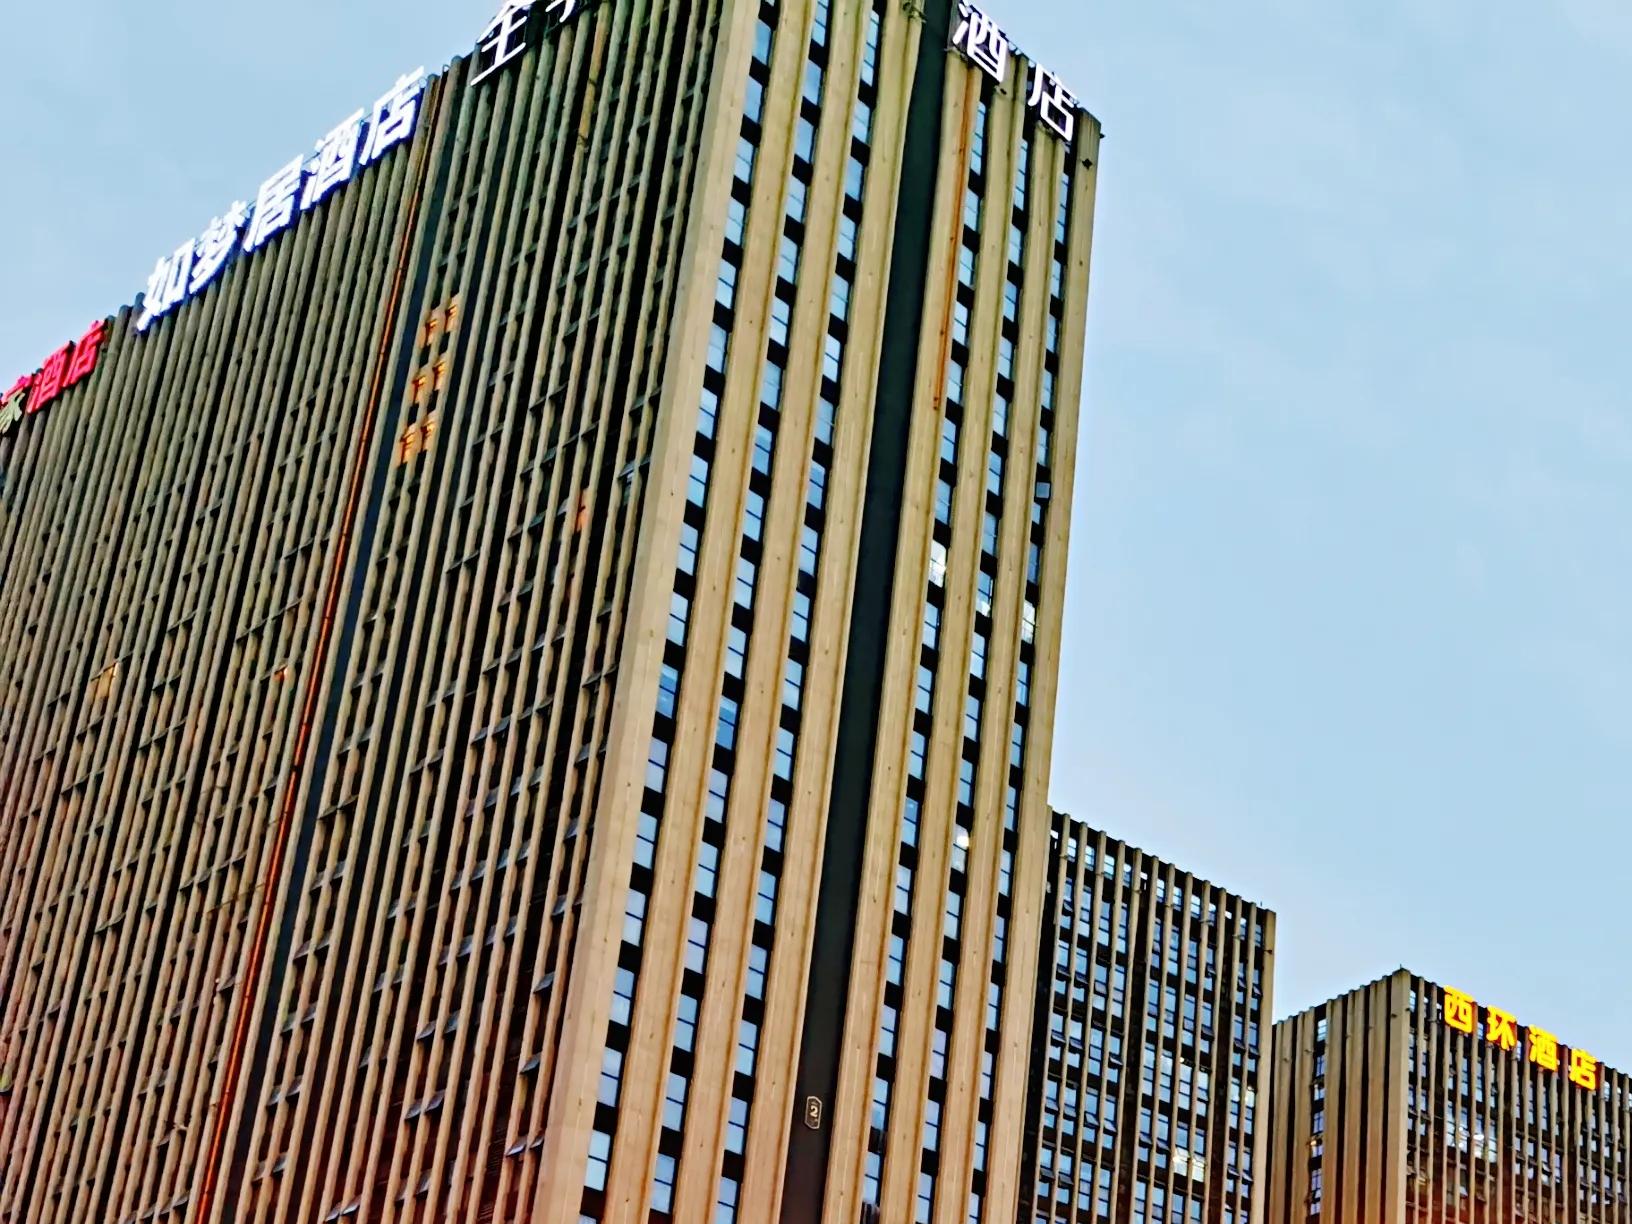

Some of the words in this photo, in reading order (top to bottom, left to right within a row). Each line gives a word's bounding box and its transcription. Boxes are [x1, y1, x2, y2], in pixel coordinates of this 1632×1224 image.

[952, 0, 1077, 142] 酒店
[137, 67, 426, 332] 如梦居酒店
[0, 319, 106, 413] 酒店
[1443, 984, 1597, 1091] 西环酒店
